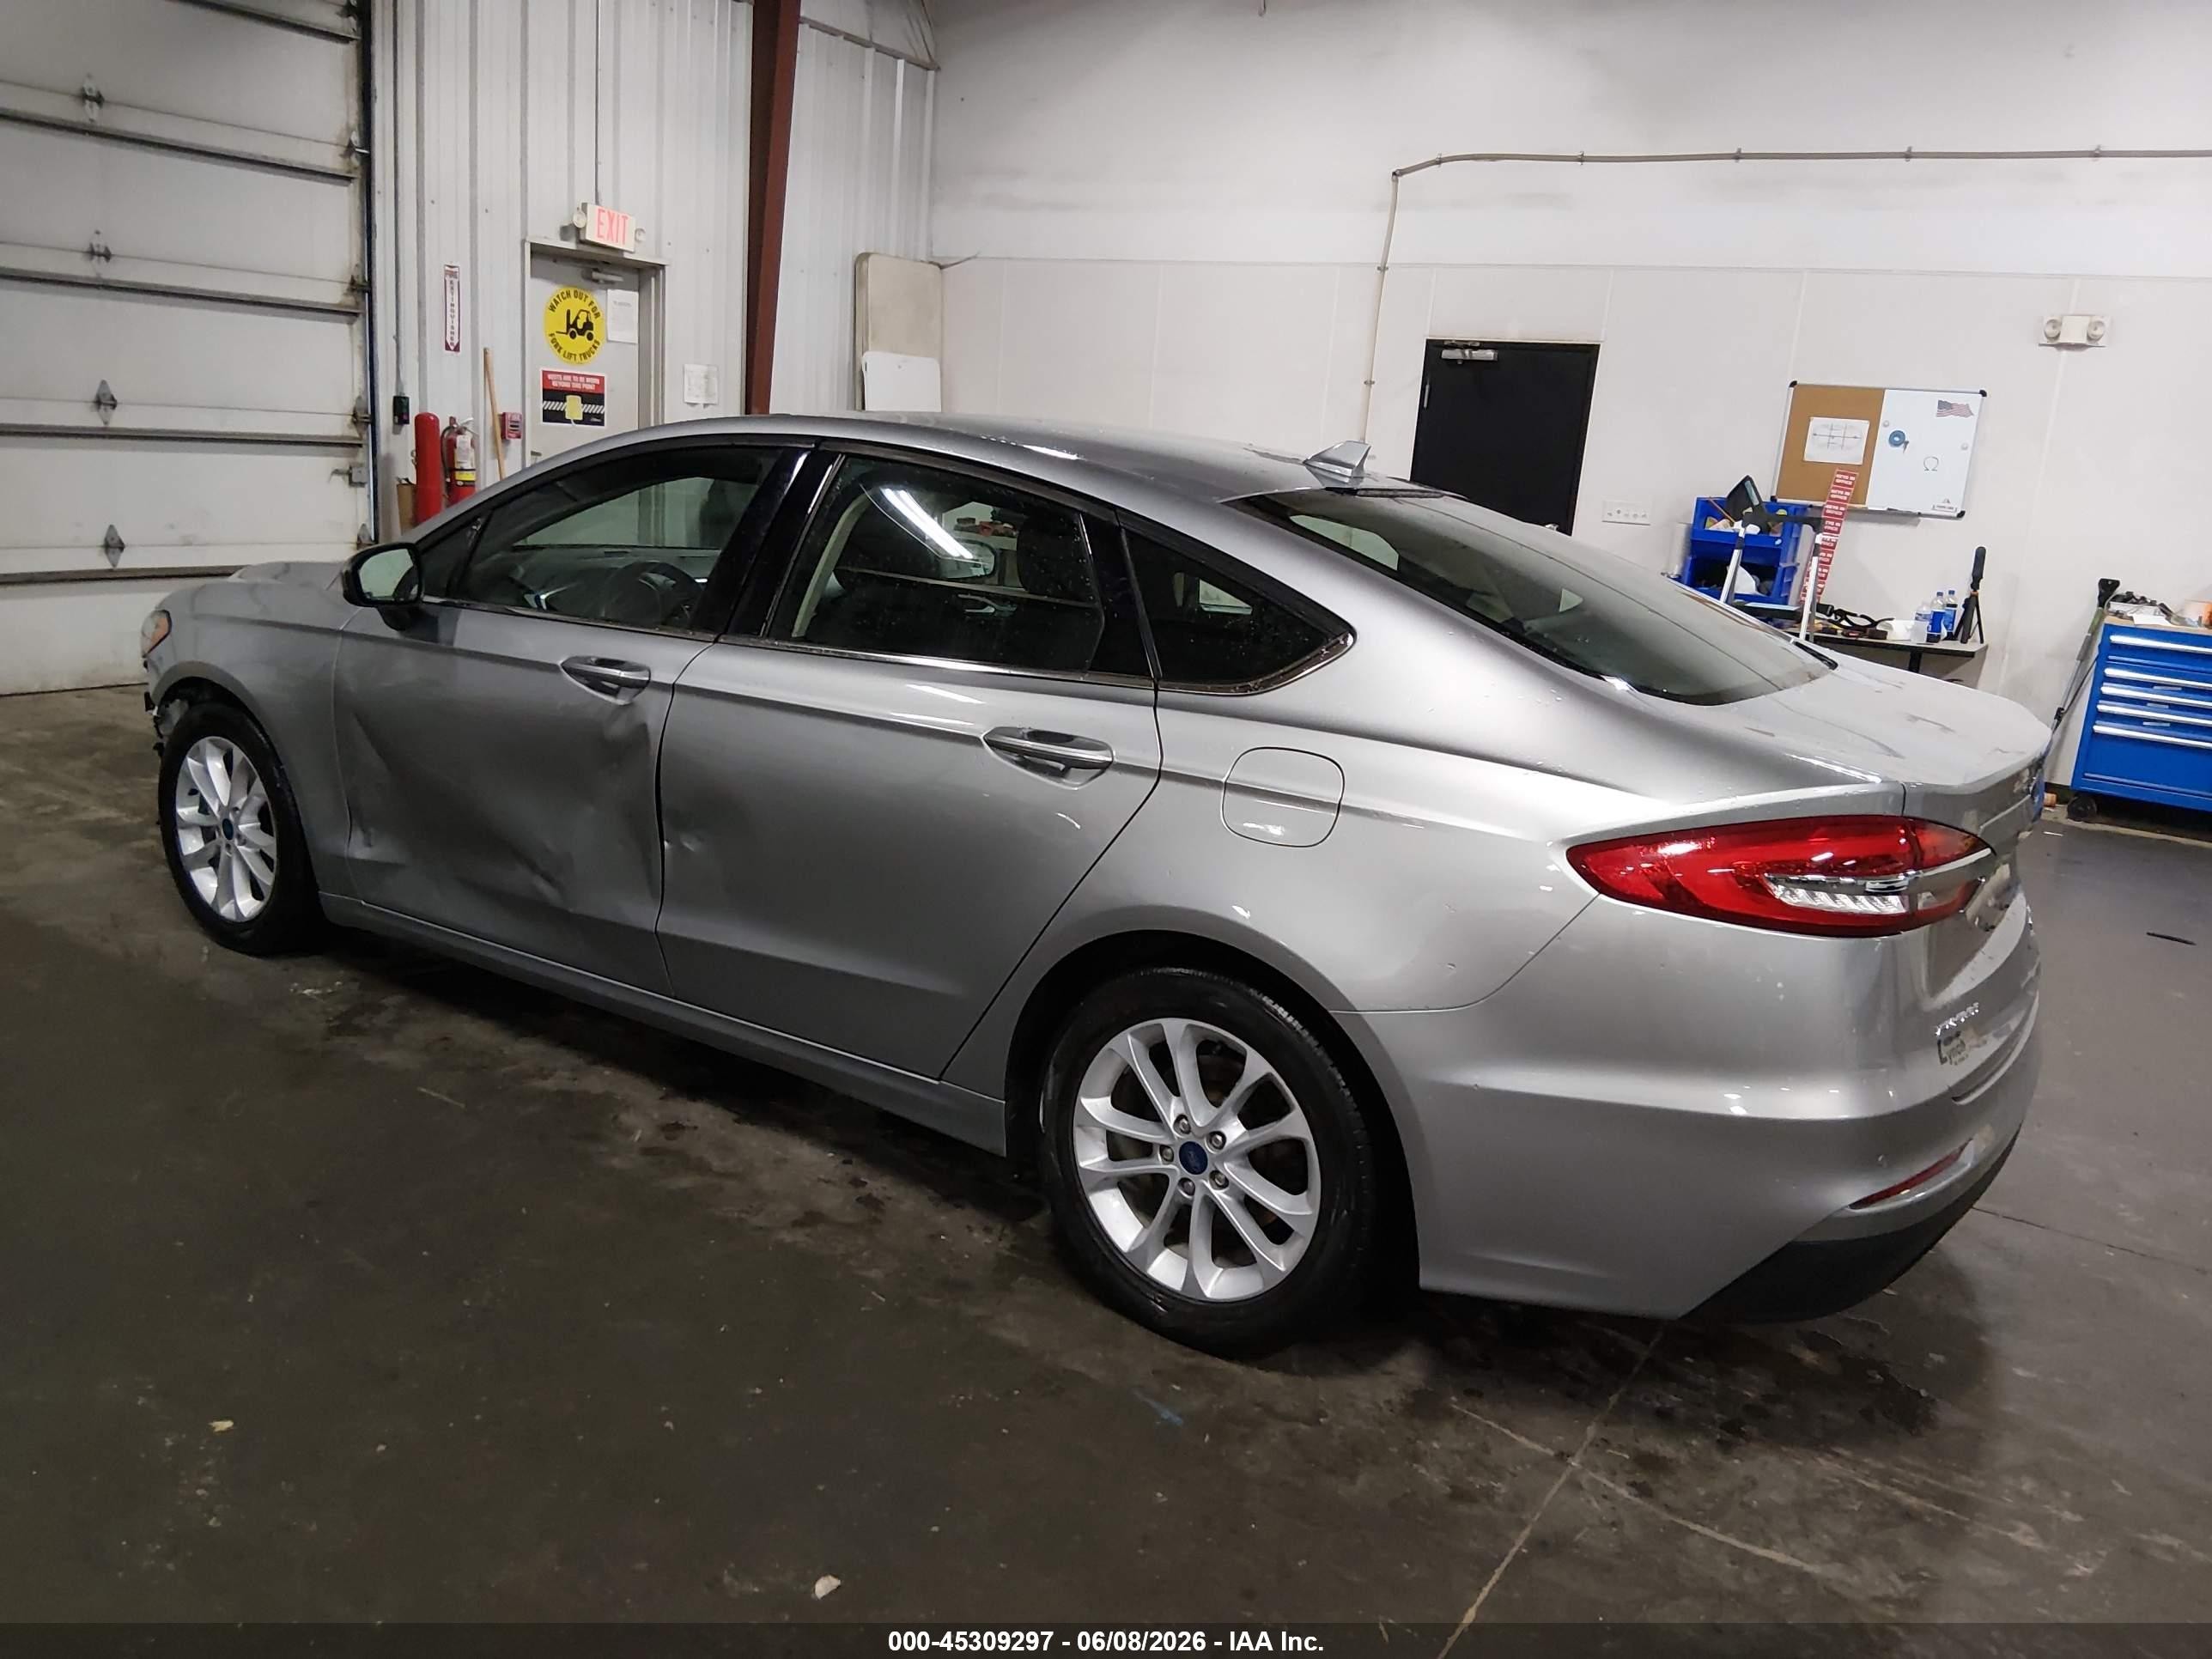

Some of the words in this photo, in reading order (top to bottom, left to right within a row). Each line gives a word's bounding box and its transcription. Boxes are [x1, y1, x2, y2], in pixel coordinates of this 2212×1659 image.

[596, 208, 629, 246] EXIT
[549, 289, 572, 313] WATCH
[573, 289, 589, 302] OUT
[587, 300, 601, 319] FOR
[548, 332, 564, 355] FORK
[562, 349, 578, 362] LIFT
[579, 338, 601, 362] TRUCKS
